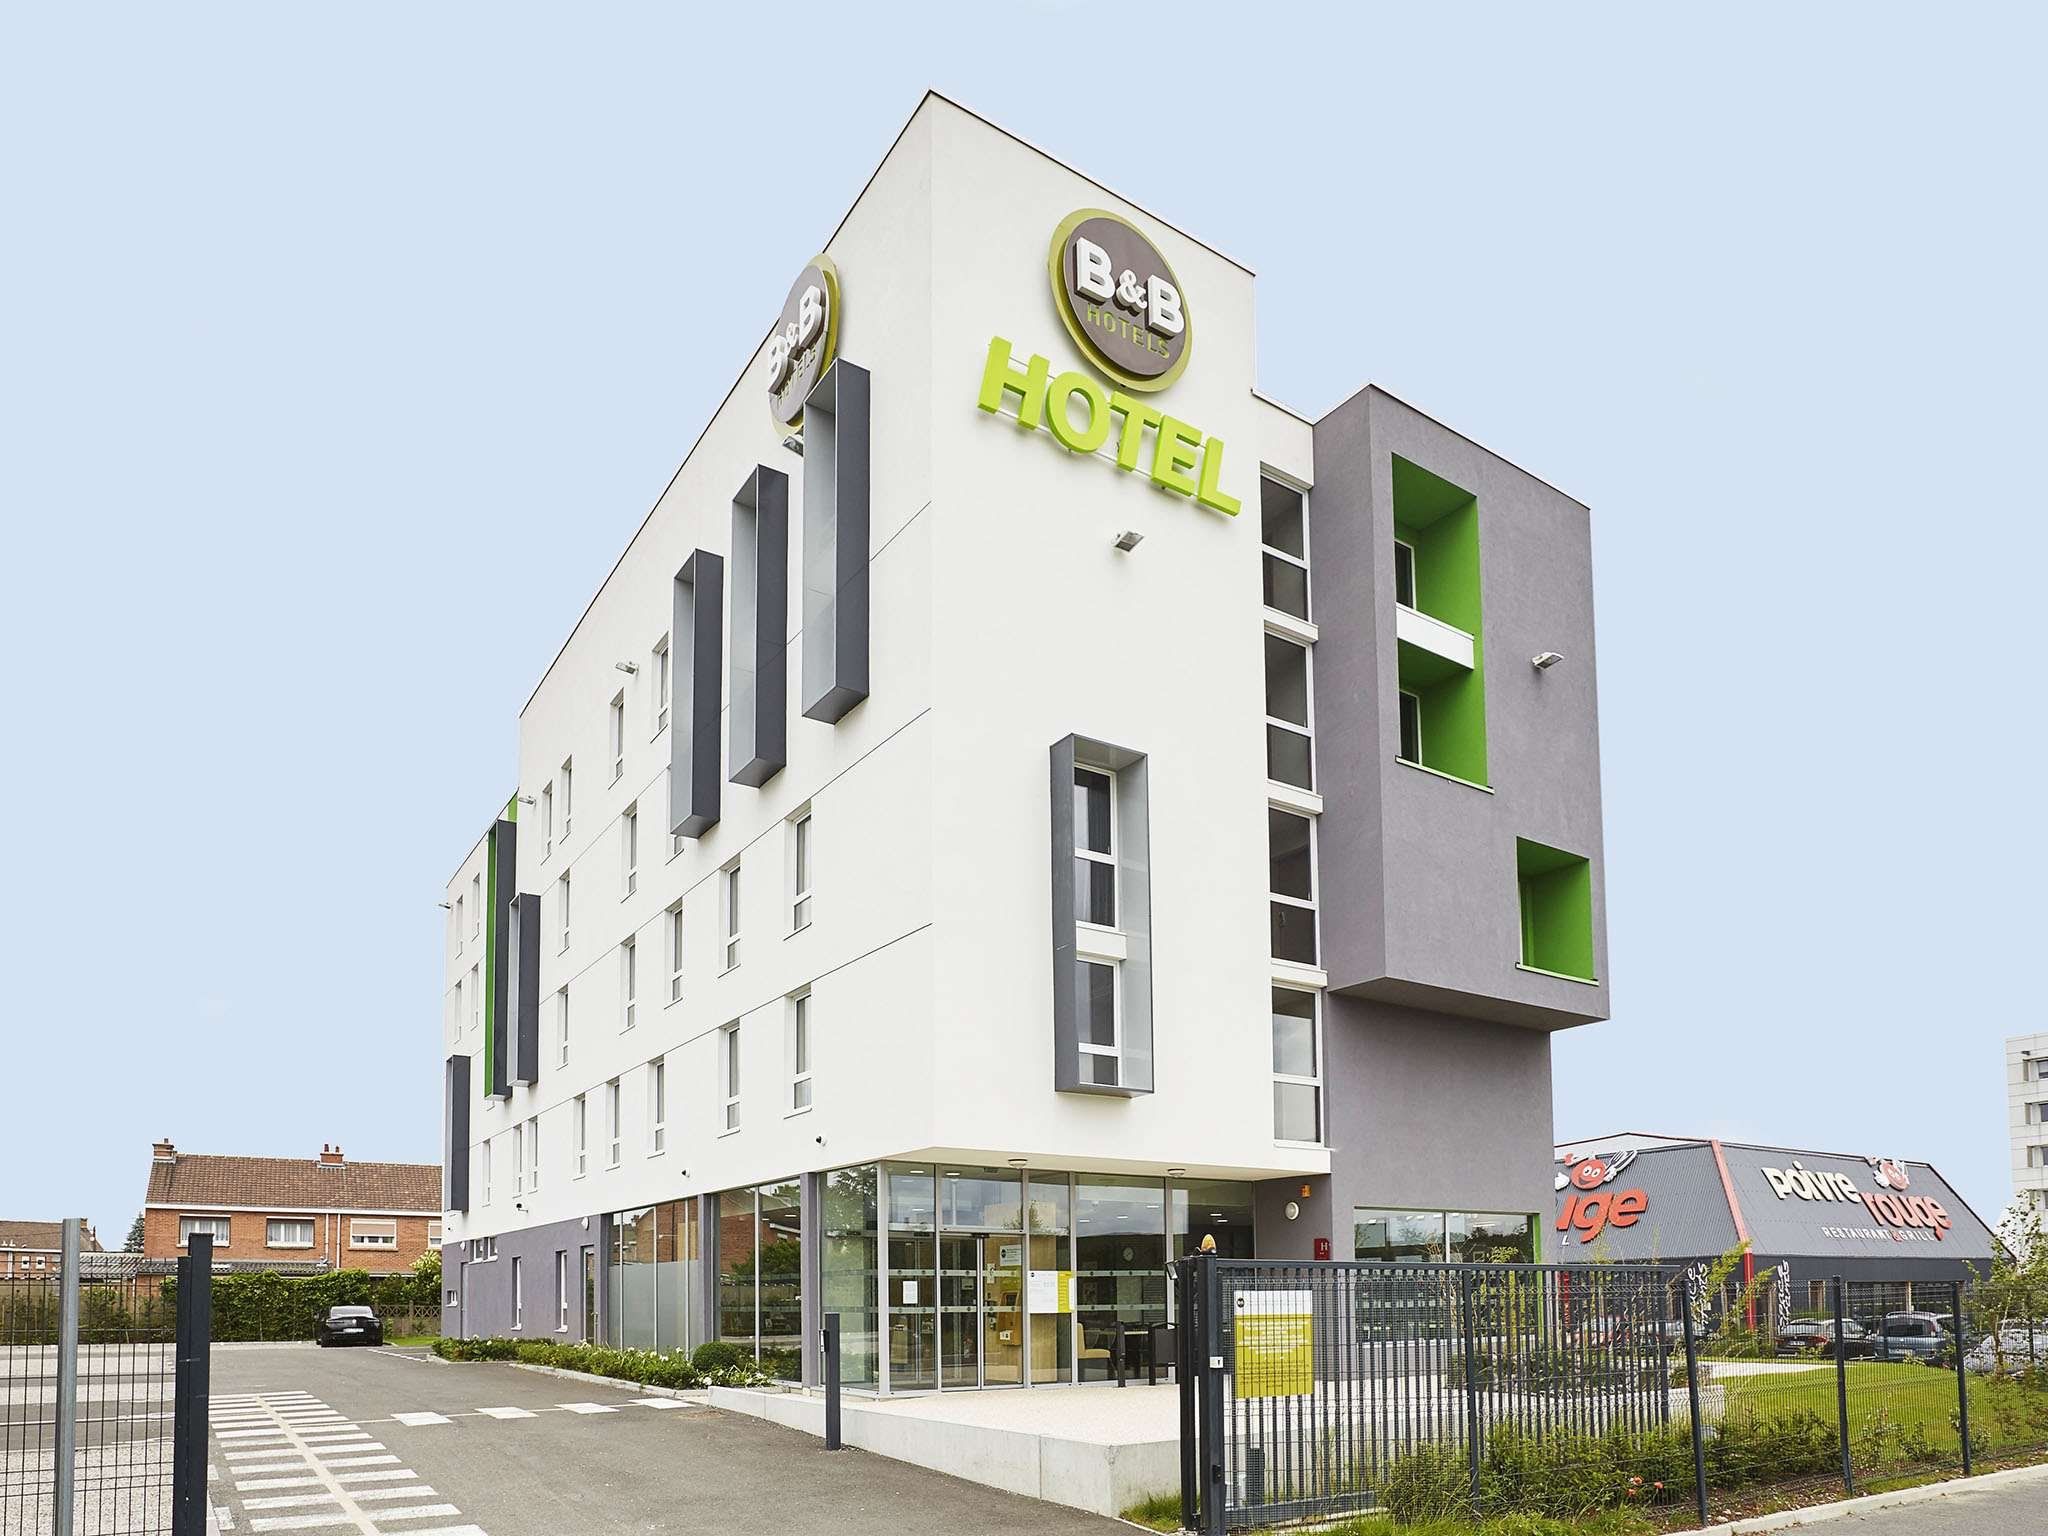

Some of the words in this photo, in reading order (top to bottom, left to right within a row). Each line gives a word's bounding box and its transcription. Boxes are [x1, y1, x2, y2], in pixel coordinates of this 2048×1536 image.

[1075, 237, 1185, 337] B&B
[1087, 303, 1170, 360] HOTELS
[768, 285, 823, 394] B&B
[977, 336, 1241, 517] HOTEL
[1822, 1227, 1891, 1240] RESTAURANT
